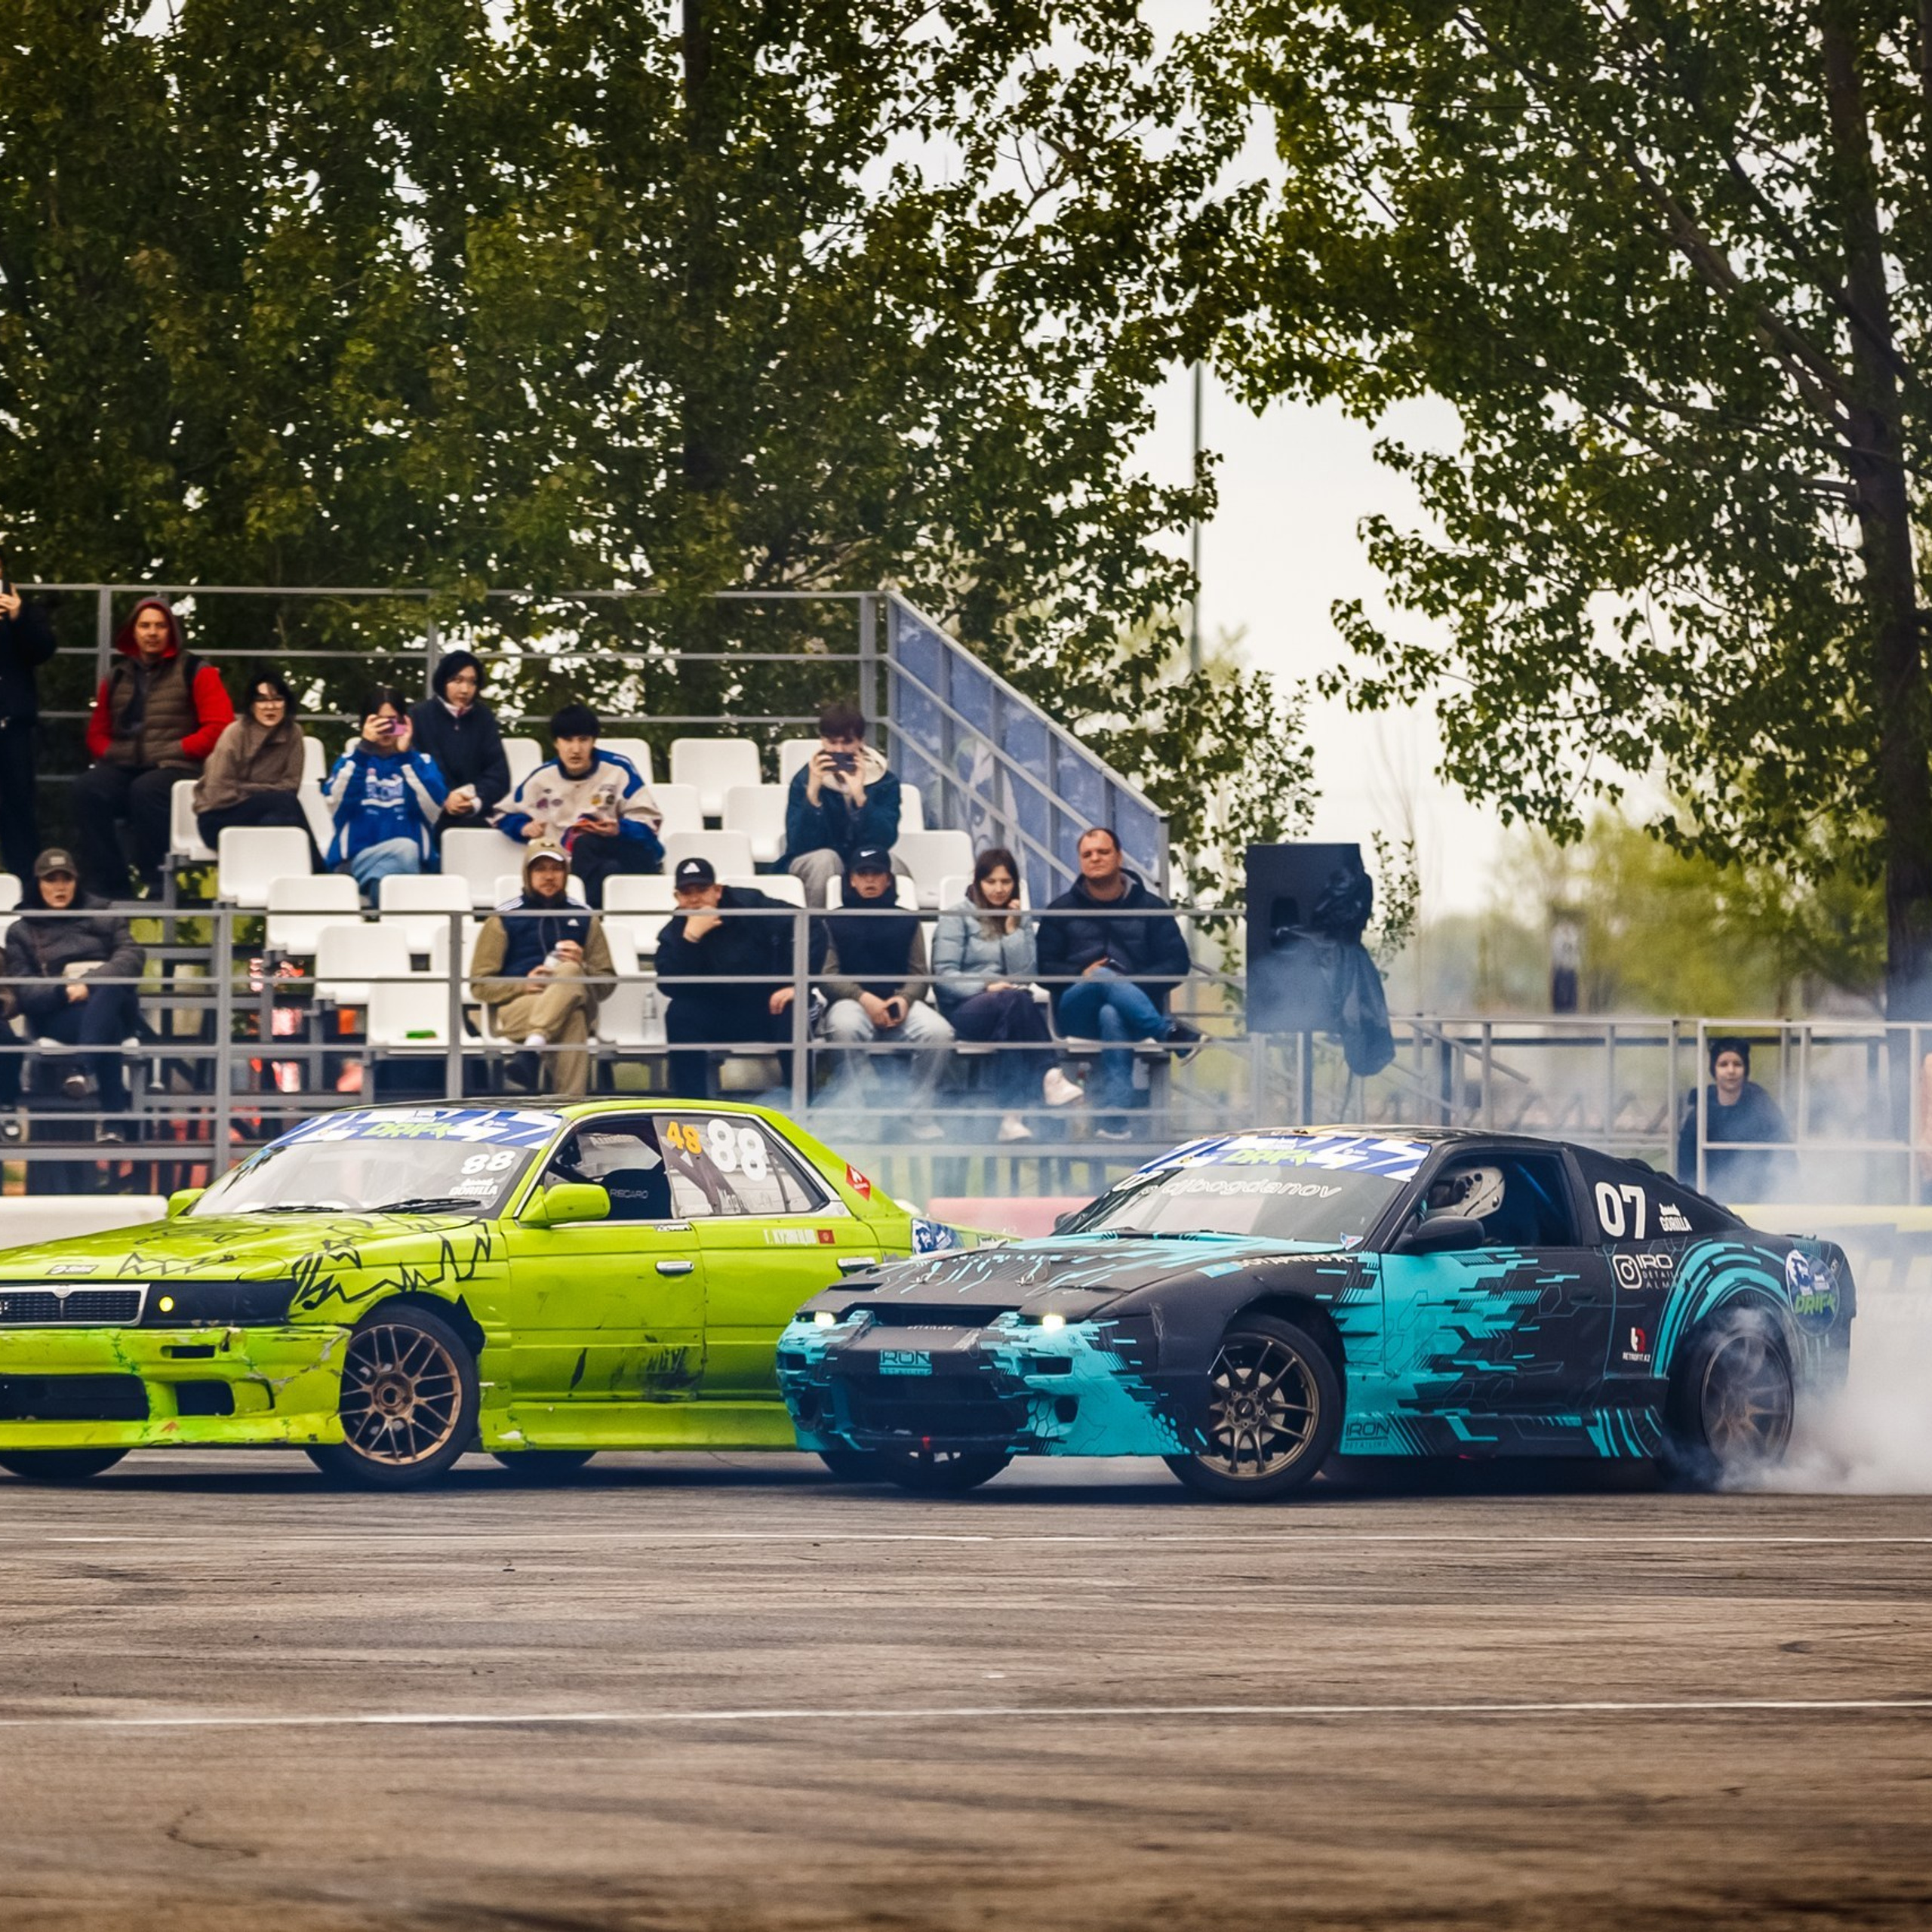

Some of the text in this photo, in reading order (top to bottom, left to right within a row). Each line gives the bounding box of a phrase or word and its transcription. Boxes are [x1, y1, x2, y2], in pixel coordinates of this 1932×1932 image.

[666, 1121, 703, 1155] 48
[708, 1119, 768, 1182] 88
[460, 1150, 516, 1175] 88
[448, 1185, 499, 1196] GORILLA
[1161, 1177, 1343, 1198] djbogdanov
[1595, 1181, 1646, 1239] 07
[1659, 1215, 1693, 1232] GORILLA
[1635, 1254, 1674, 1269] IRO
[1346, 1422, 1389, 1437] IRON
